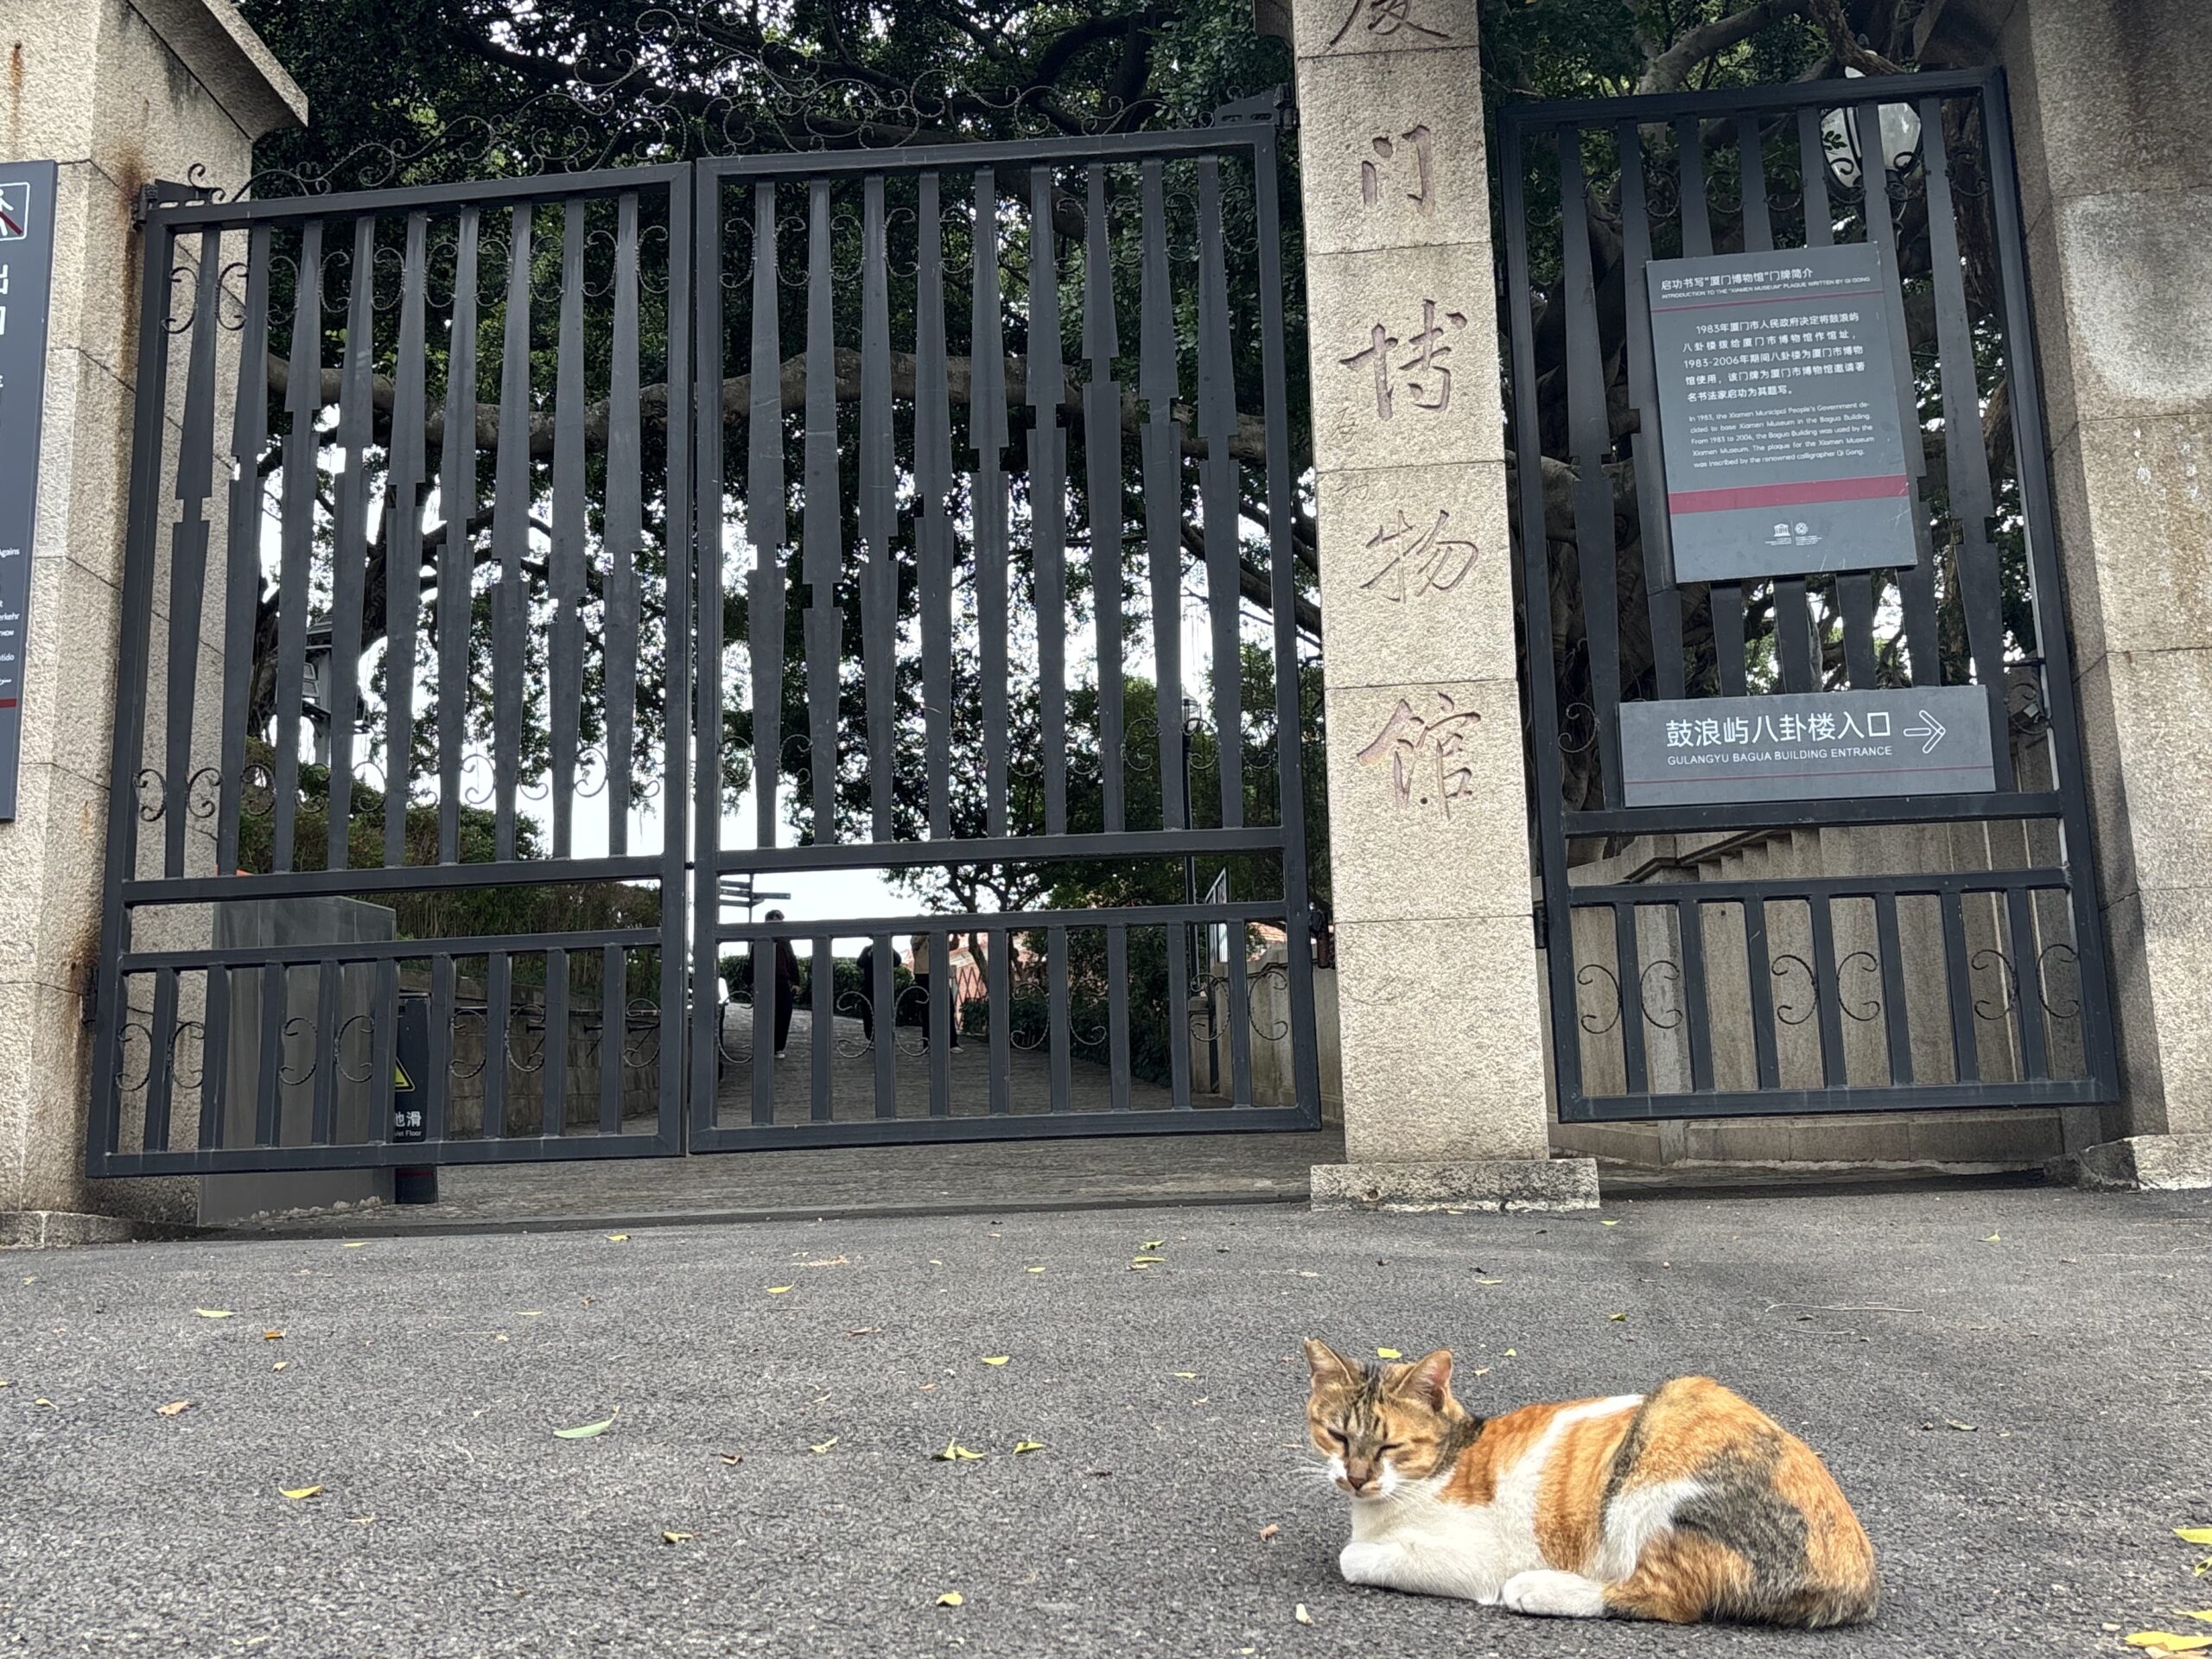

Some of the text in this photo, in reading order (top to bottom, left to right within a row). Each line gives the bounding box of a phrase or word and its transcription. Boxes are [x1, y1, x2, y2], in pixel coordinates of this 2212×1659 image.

[1696, 312, 1859, 334] 1983年厦门市人民政府决定将鼓浪屿
[1684, 346, 1864, 369] 1983-2006年期间八卦楼为厦门市博物
[1688, 385, 1792, 403] 名书法家启功为其题写。
[1755, 408, 1787, 416] Municipal
[1788, 405, 1815, 414] People's
[1817, 403, 1857, 411] Government
[1709, 458, 1738, 467] inscribed
[1763, 454, 1796, 462] renowned
[1796, 451, 1835, 460] calligrapher
[1665, 711, 1891, 747] 鼓浪屿八卦楼入口
[1668, 746, 1892, 766] GULANGYU BAGUA BUILDING ENTRANCE
